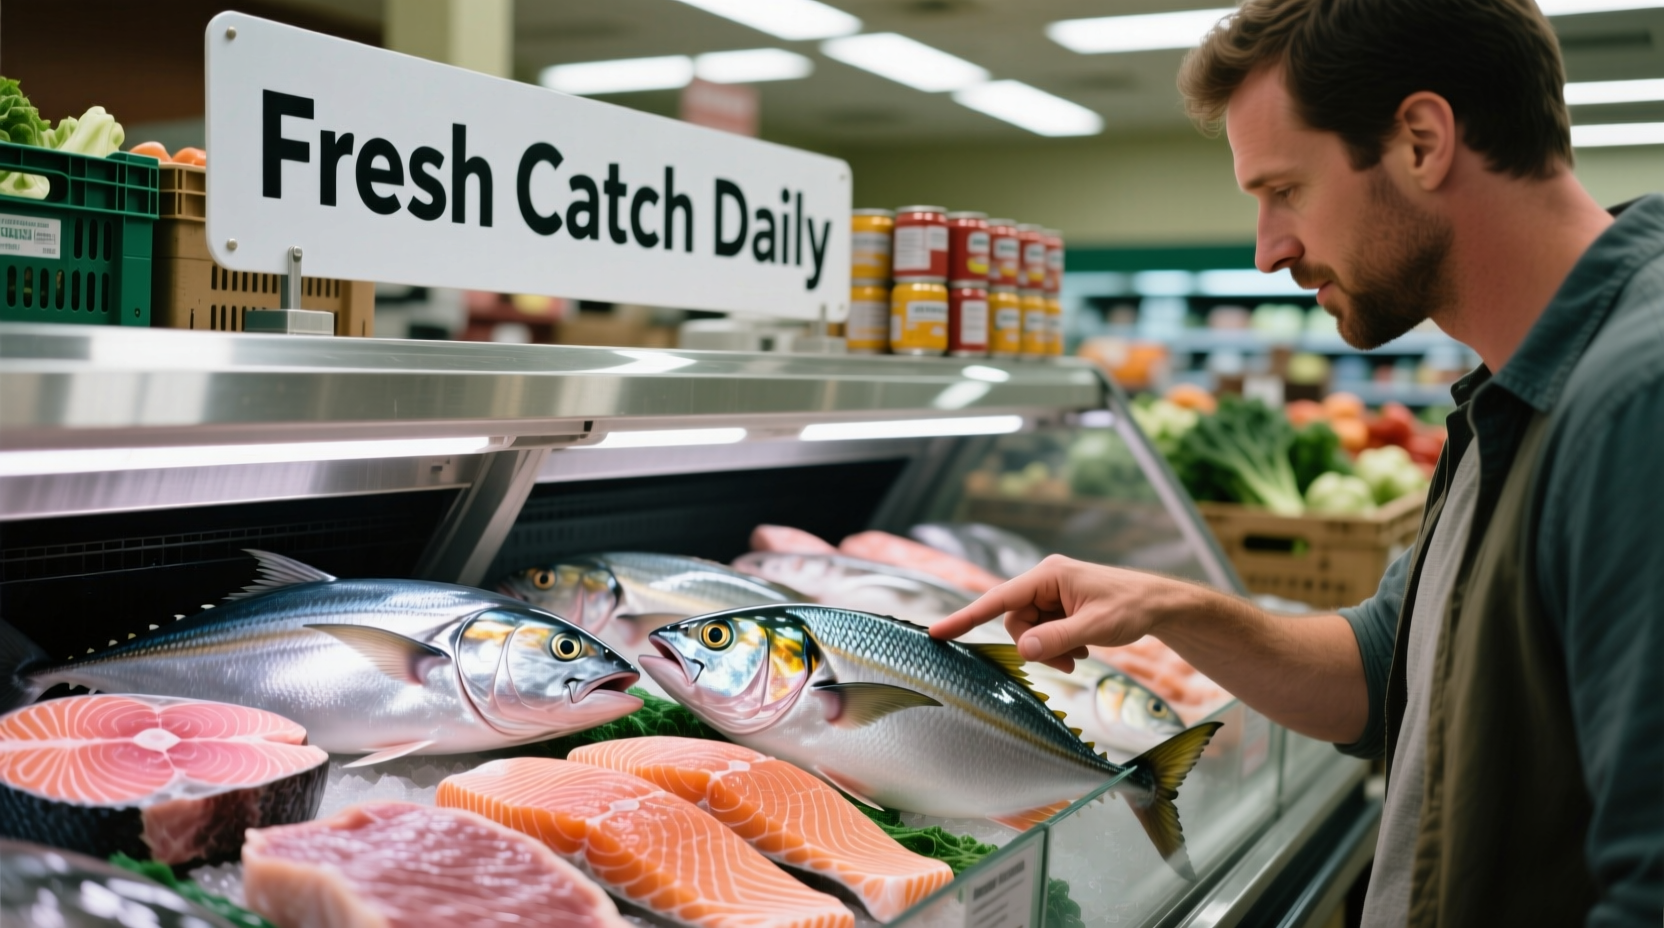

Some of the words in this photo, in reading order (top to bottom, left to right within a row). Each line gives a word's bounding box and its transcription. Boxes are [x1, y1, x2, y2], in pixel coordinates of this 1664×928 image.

[262, 89, 493, 228] Fresh
[516, 142, 693, 253] Catch
[714, 179, 832, 290] Daily
